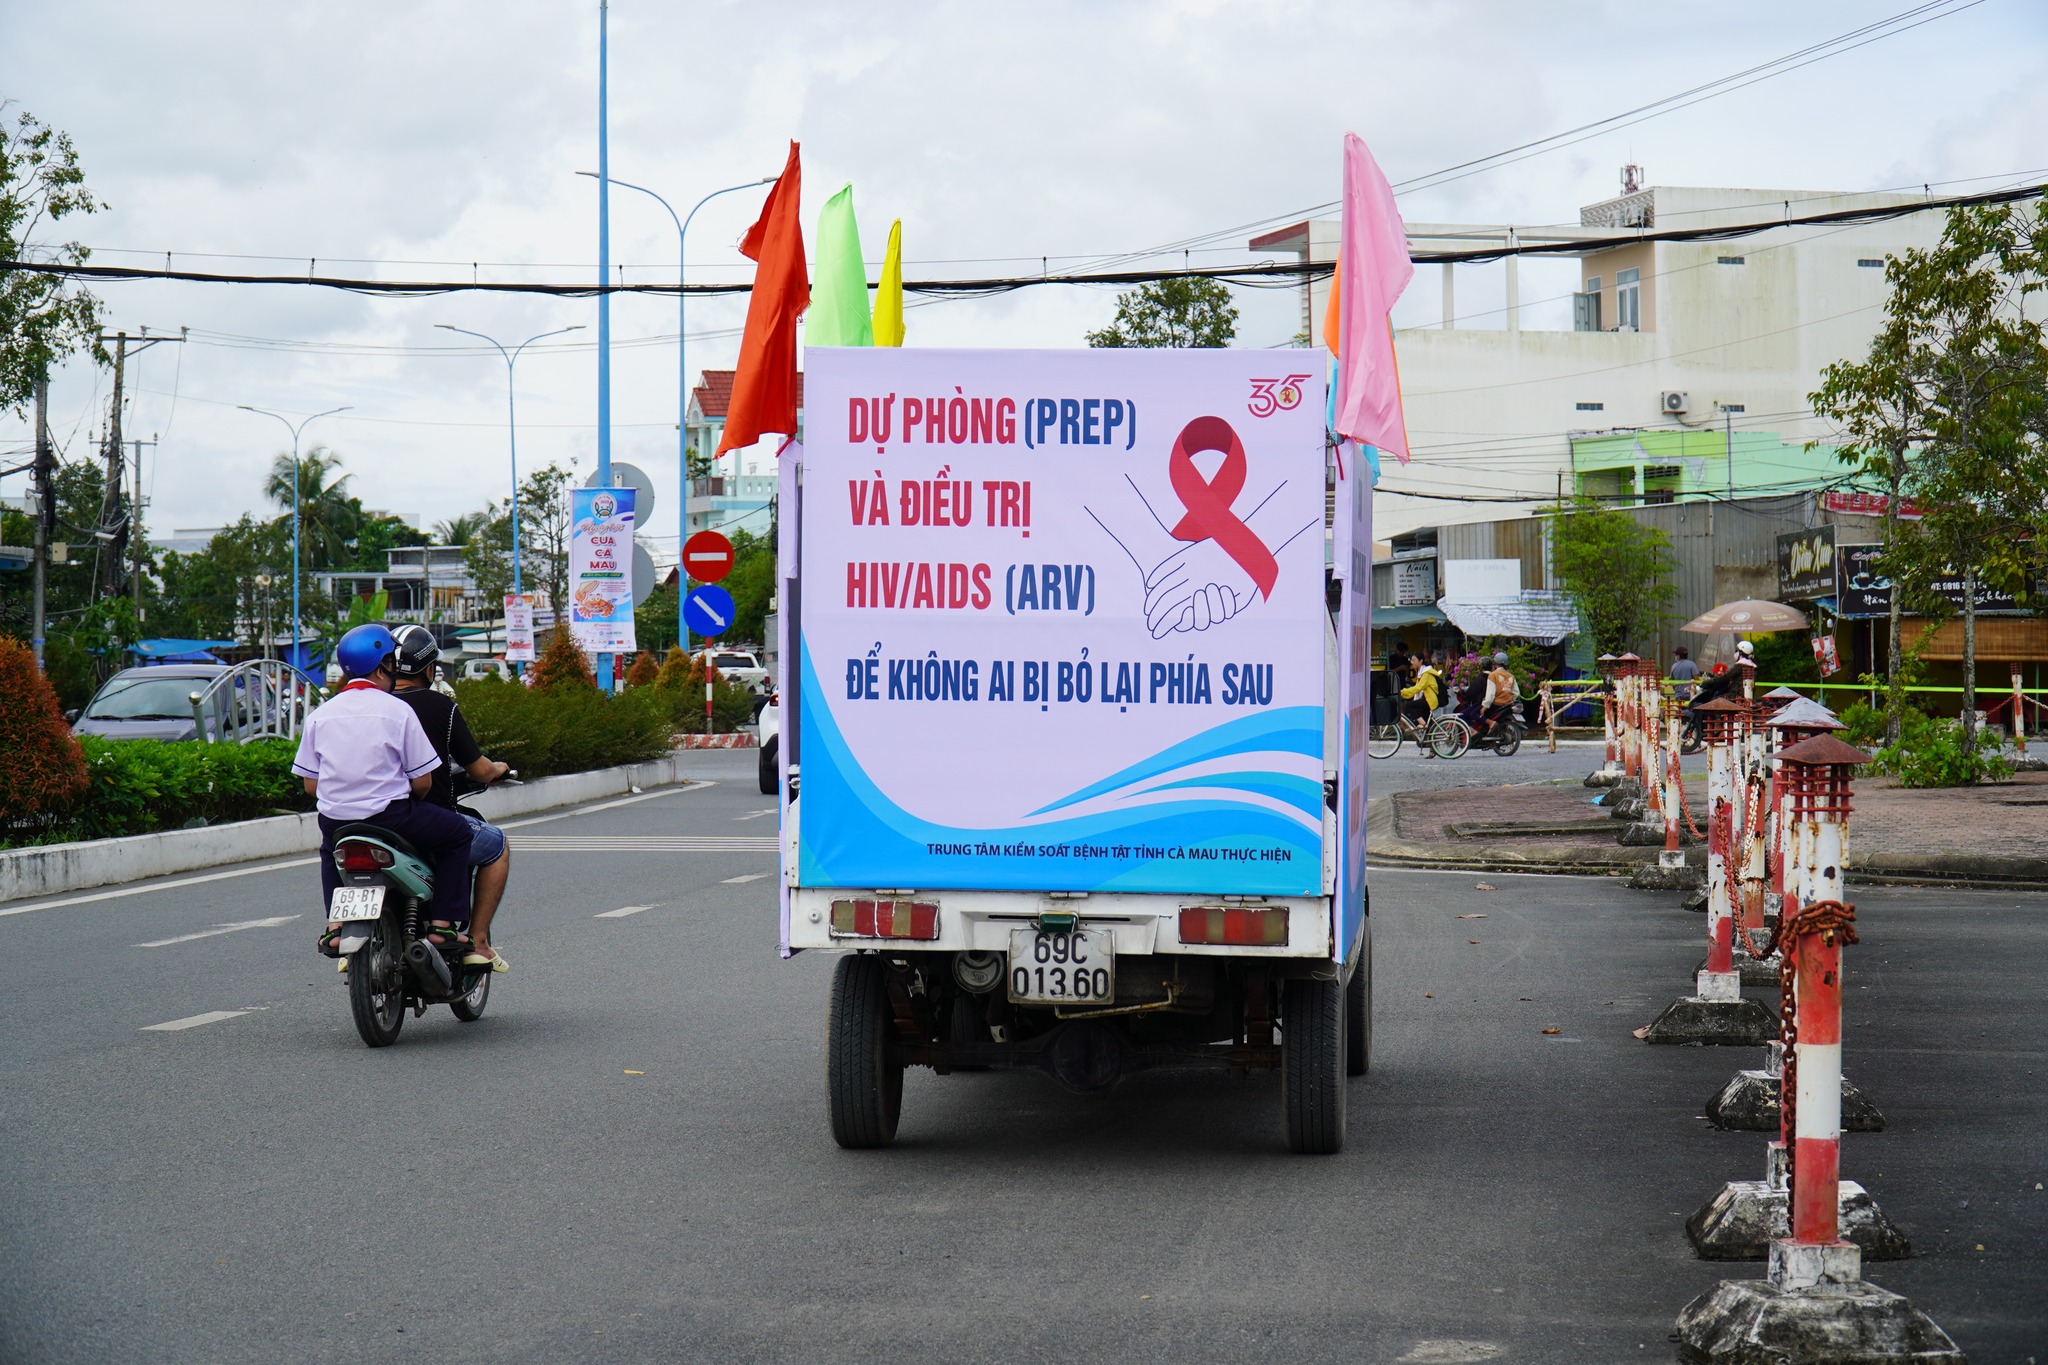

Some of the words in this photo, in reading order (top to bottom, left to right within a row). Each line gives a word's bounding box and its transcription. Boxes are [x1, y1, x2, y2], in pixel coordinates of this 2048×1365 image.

[848, 392, 896, 454] DỰ
[902, 385, 1016, 444] PHÒNG
[1024, 398, 1136, 451] (PREP)
[848, 469, 890, 526] VÀ
[899, 464, 973, 527] ĐIỀU
[982, 480, 1031, 538] TRỊ
[590, 536, 616, 546] CUA
[589, 561, 617, 571] MAU
[1406, 563, 1429, 573] Nails
[846, 561, 992, 611] HIV/AIDS
[1005, 563, 1095, 616] (ARV)
[1863, 594, 1887, 605] Hân
[846, 641, 882, 700] ĐỂ
[888, 651, 979, 702] KHÔNG
[987, 660, 1015, 702] AI
[1022, 660, 1049, 712] BỊ
[1057, 646, 1093, 703] BỎ
[1100, 661, 1141, 713] LẠI
[1149, 653, 1213, 705] PHÍA
[1221, 662, 1274, 706] SAU
[926, 843, 972, 856] TRUNG
[974, 842, 1001, 857] TÂM
[1003, 841, 1035, 857] KIỂM
[1038, 843, 1070, 858] SOÁT
[1073, 844, 1109, 861] BỆNH
[1111, 844, 1131, 862] TẬT
[1133, 843, 1165, 859] TỈNH
[1167, 845, 1185, 860] CÀ
[1188, 848, 1219, 861] MAU
[1221, 847, 1258, 864] THỰC
[1260, 847, 1291, 865] HIỆN
[340, 889, 376, 903] 69-B1
[333, 903, 378, 919] 264.16
[1034, 932, 1088, 964] 69C
